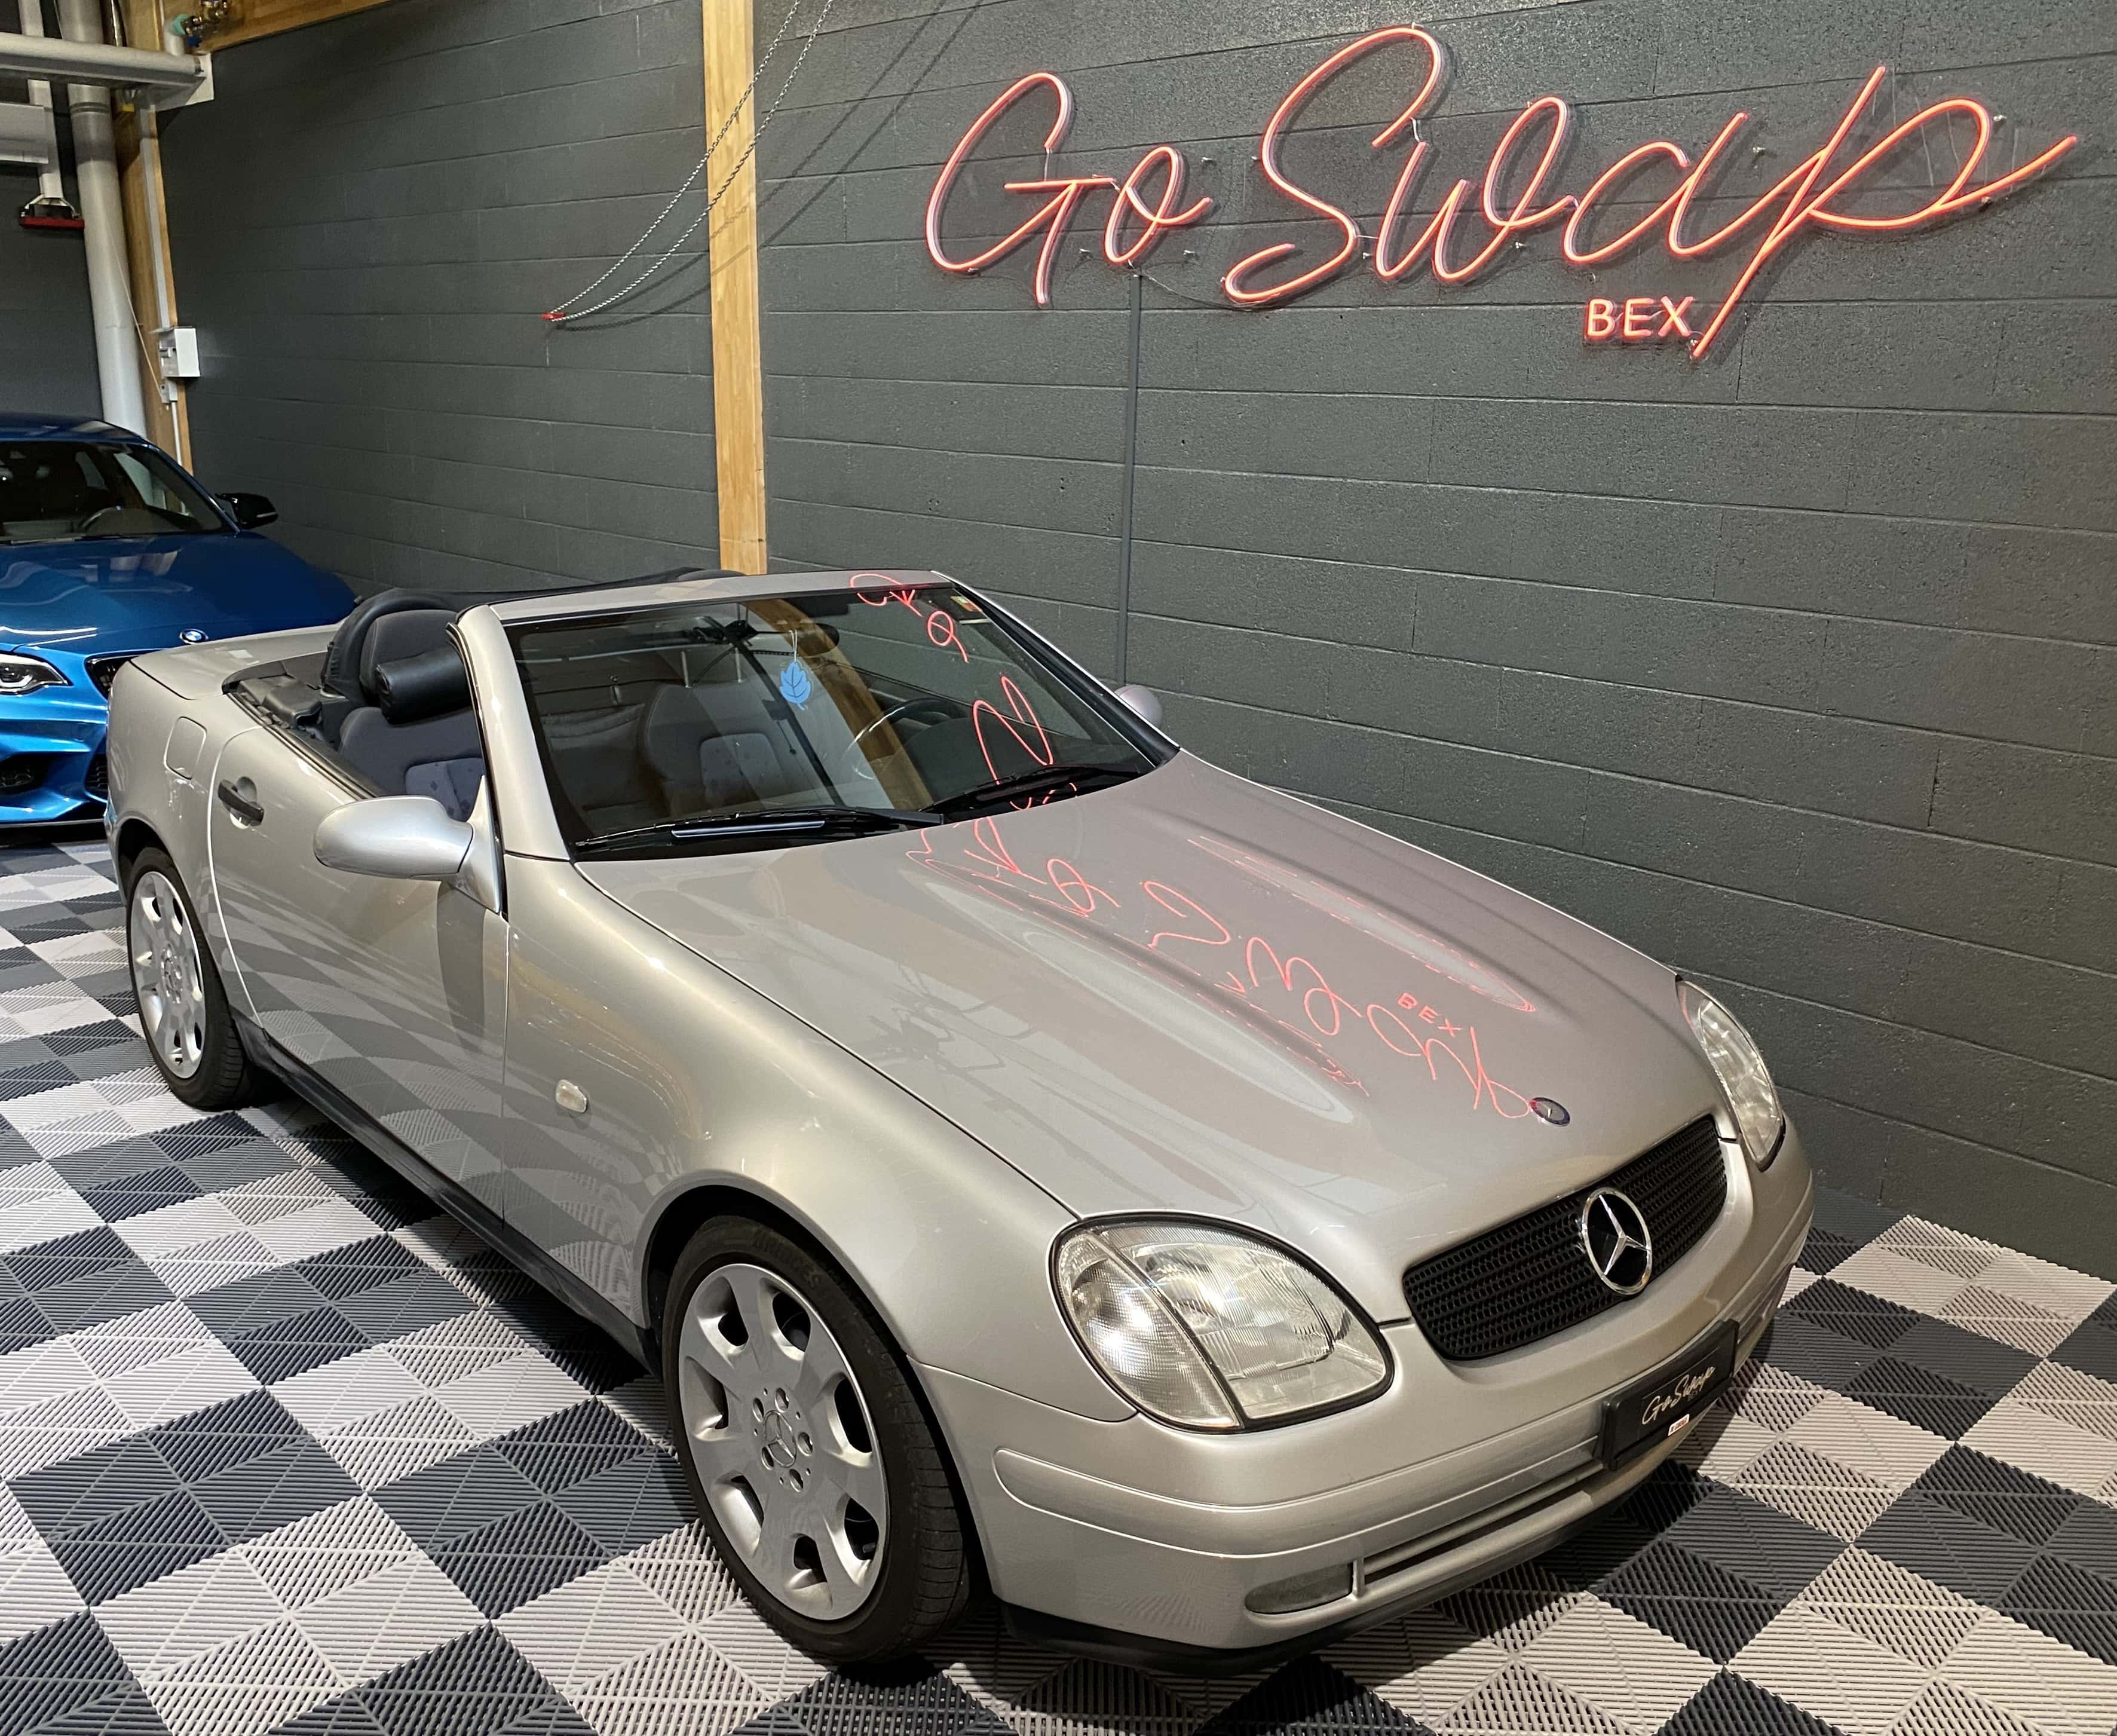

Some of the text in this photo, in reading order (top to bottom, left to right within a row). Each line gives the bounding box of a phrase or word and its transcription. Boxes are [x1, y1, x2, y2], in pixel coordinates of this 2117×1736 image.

[926, 25, 2077, 359] Go Swap
[1586, 295, 1695, 339] BEX
